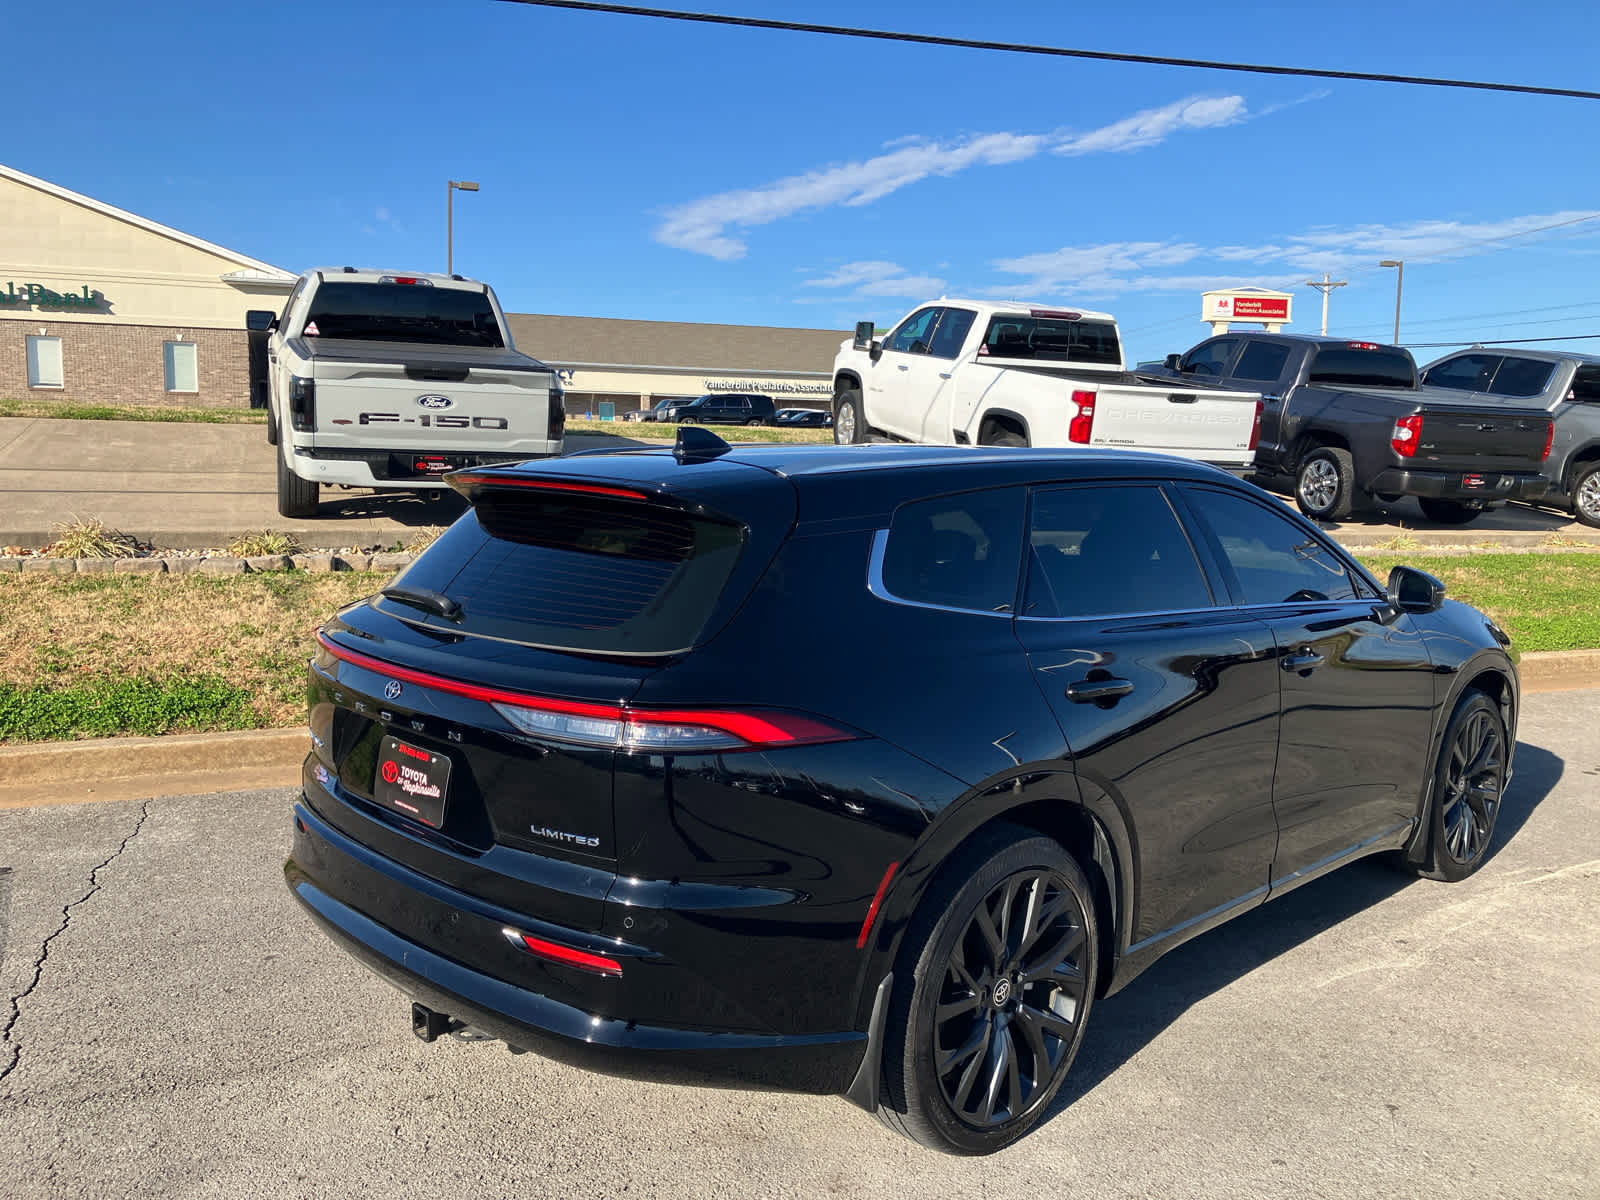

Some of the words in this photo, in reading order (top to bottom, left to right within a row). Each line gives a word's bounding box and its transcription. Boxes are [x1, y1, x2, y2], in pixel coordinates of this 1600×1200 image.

[24, 283, 97, 305] Bank
[558, 368, 575, 380] CY
[704, 380, 751, 390] Vanderbilt
[752, 381, 793, 393] Pediatric
[793, 383, 833, 394] Associat
[420, 396, 450, 409] Ford
[359, 412, 508, 430] F-150
[401, 765, 428, 785] TOYOTA
[530, 824, 600, 847] LIMITED
